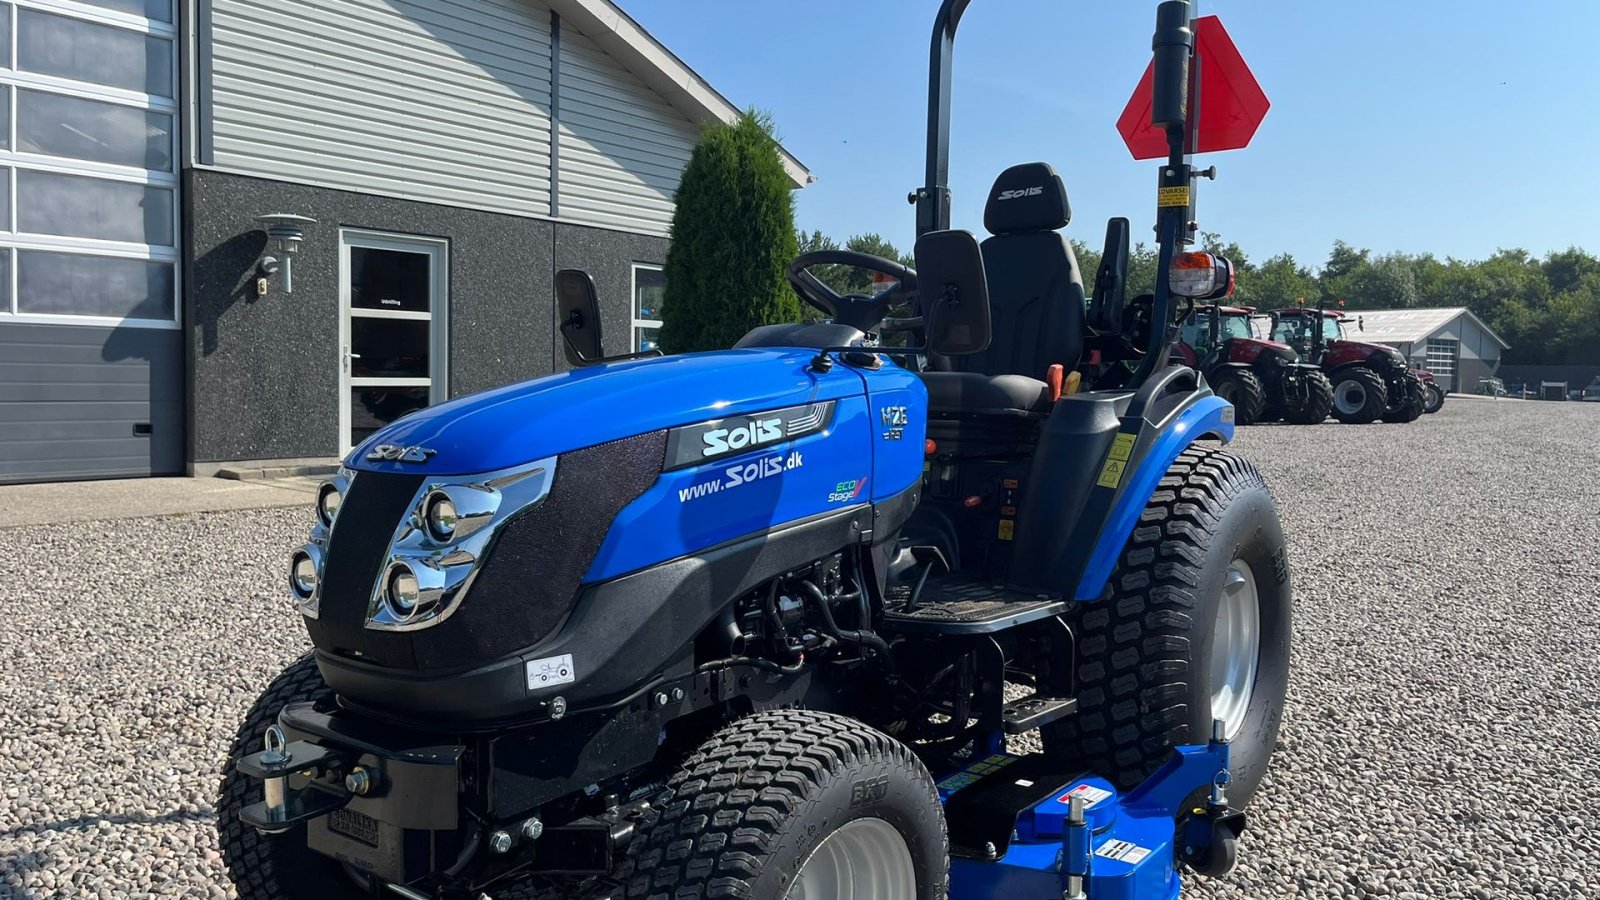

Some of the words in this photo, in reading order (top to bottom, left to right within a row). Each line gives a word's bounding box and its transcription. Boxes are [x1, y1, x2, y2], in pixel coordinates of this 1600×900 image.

[702, 418, 782, 457] Solis
[836, 480, 857, 492] ECO
[828, 490, 855, 502] Stage
